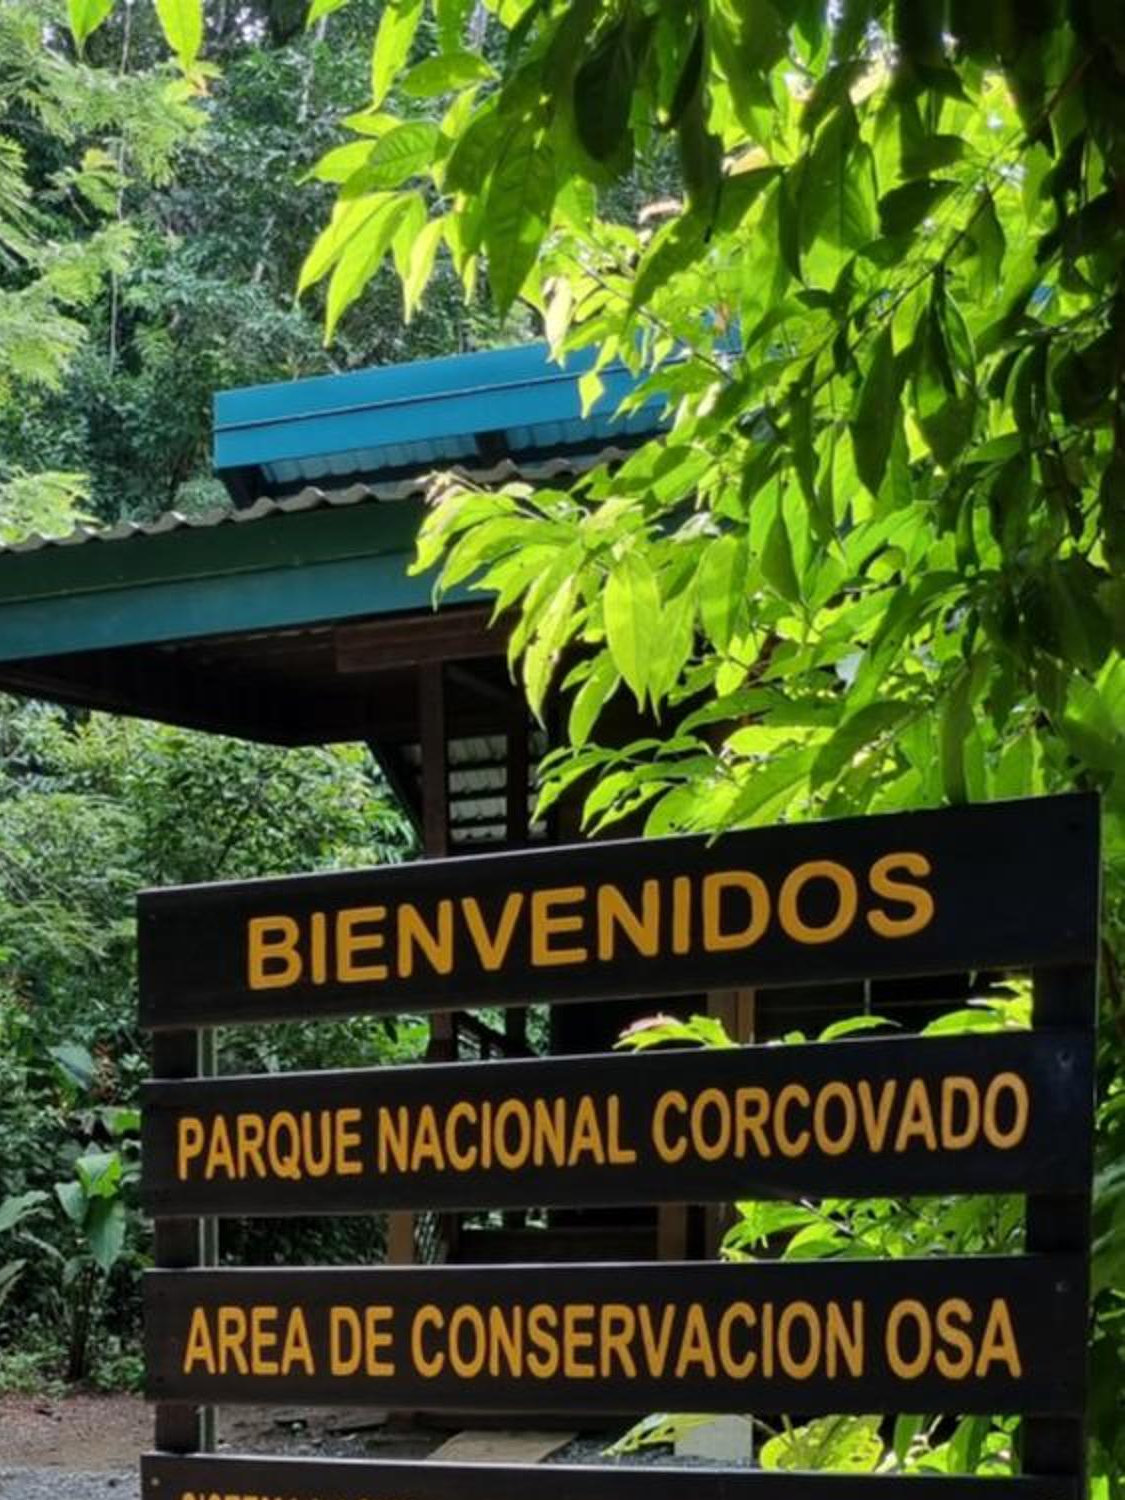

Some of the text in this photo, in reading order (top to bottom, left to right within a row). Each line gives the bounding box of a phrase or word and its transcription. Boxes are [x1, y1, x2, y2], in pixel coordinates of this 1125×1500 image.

[248, 853, 934, 990] BIENVENIDOS
[178, 1072, 1029, 1180] PARQUE NACIONAL CORCOVADO
[183, 1298, 1021, 1379] AREA DE CONSERVACION OSA
